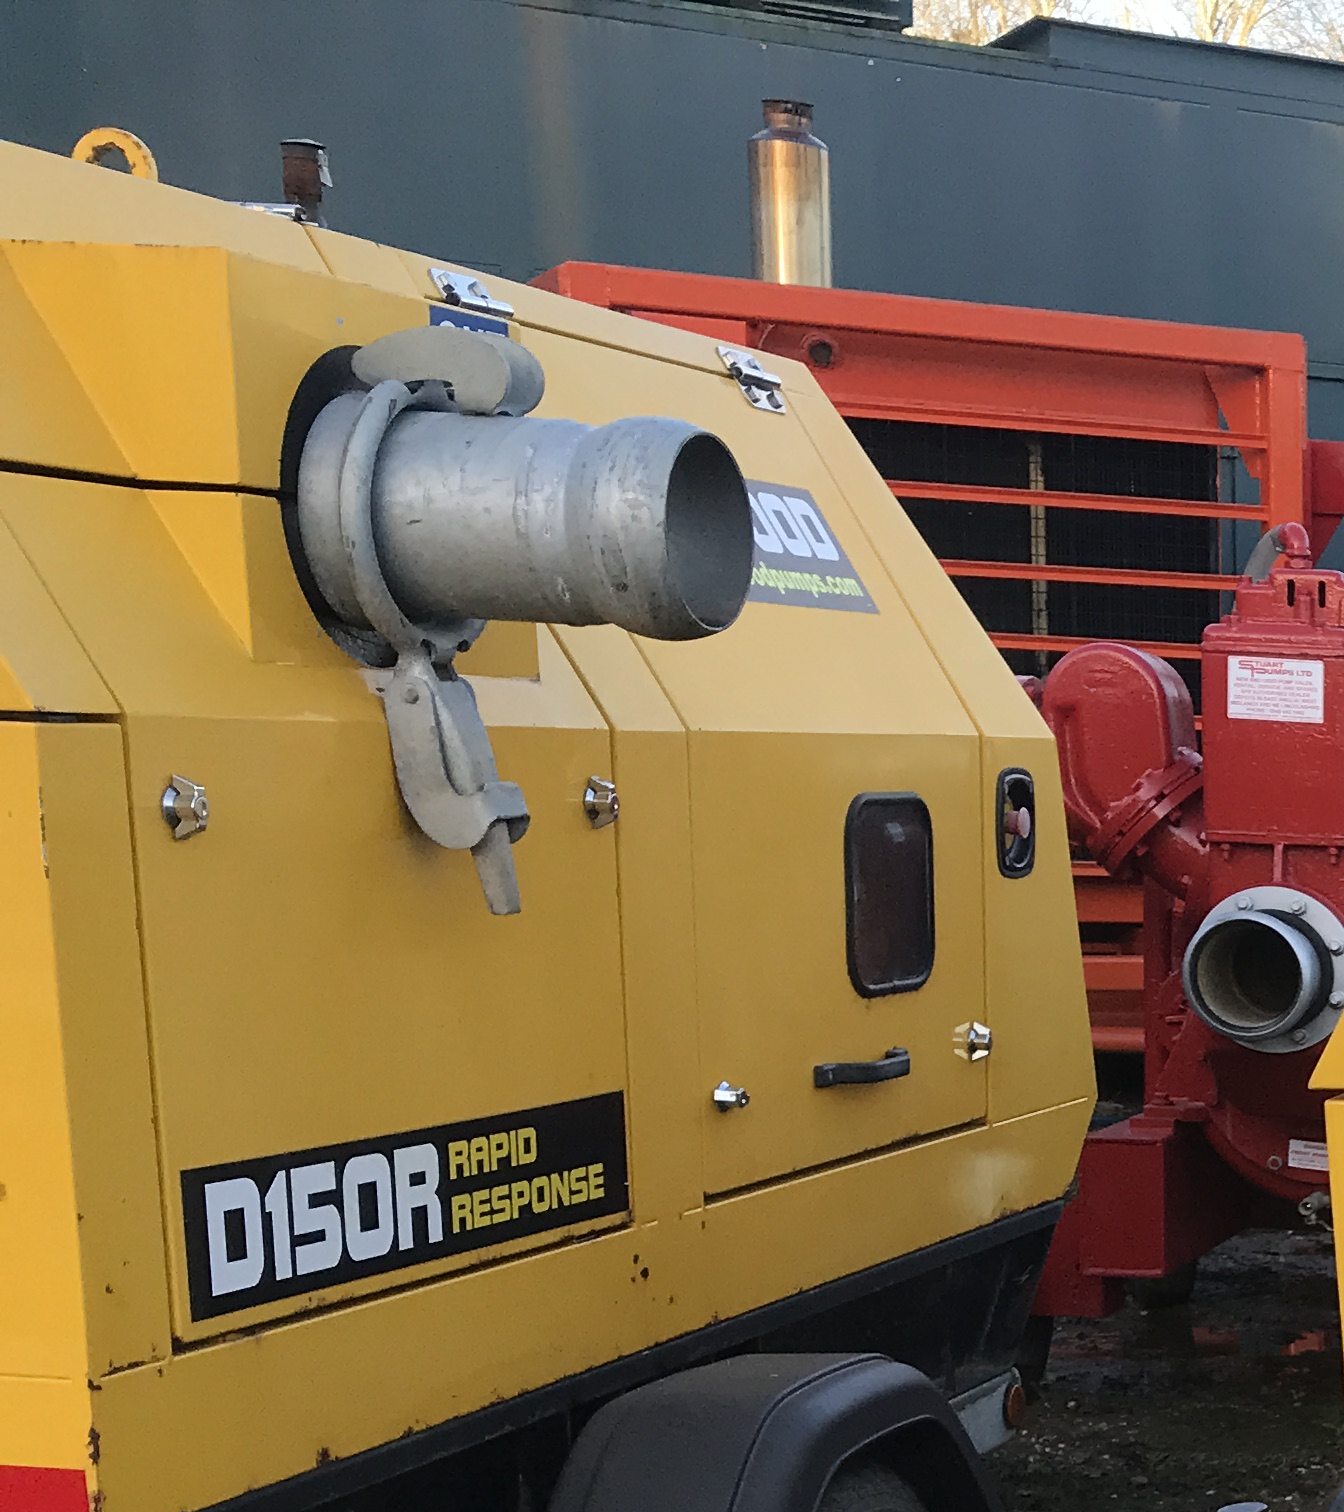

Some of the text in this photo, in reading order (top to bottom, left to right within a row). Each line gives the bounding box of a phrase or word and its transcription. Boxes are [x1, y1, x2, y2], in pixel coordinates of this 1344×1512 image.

[1238, 660, 1284, 670] STUART
[448, 1127, 538, 1181] RAPID
[205, 1142, 444, 1297] D150R
[452, 1163, 605, 1234] RESPONSE
